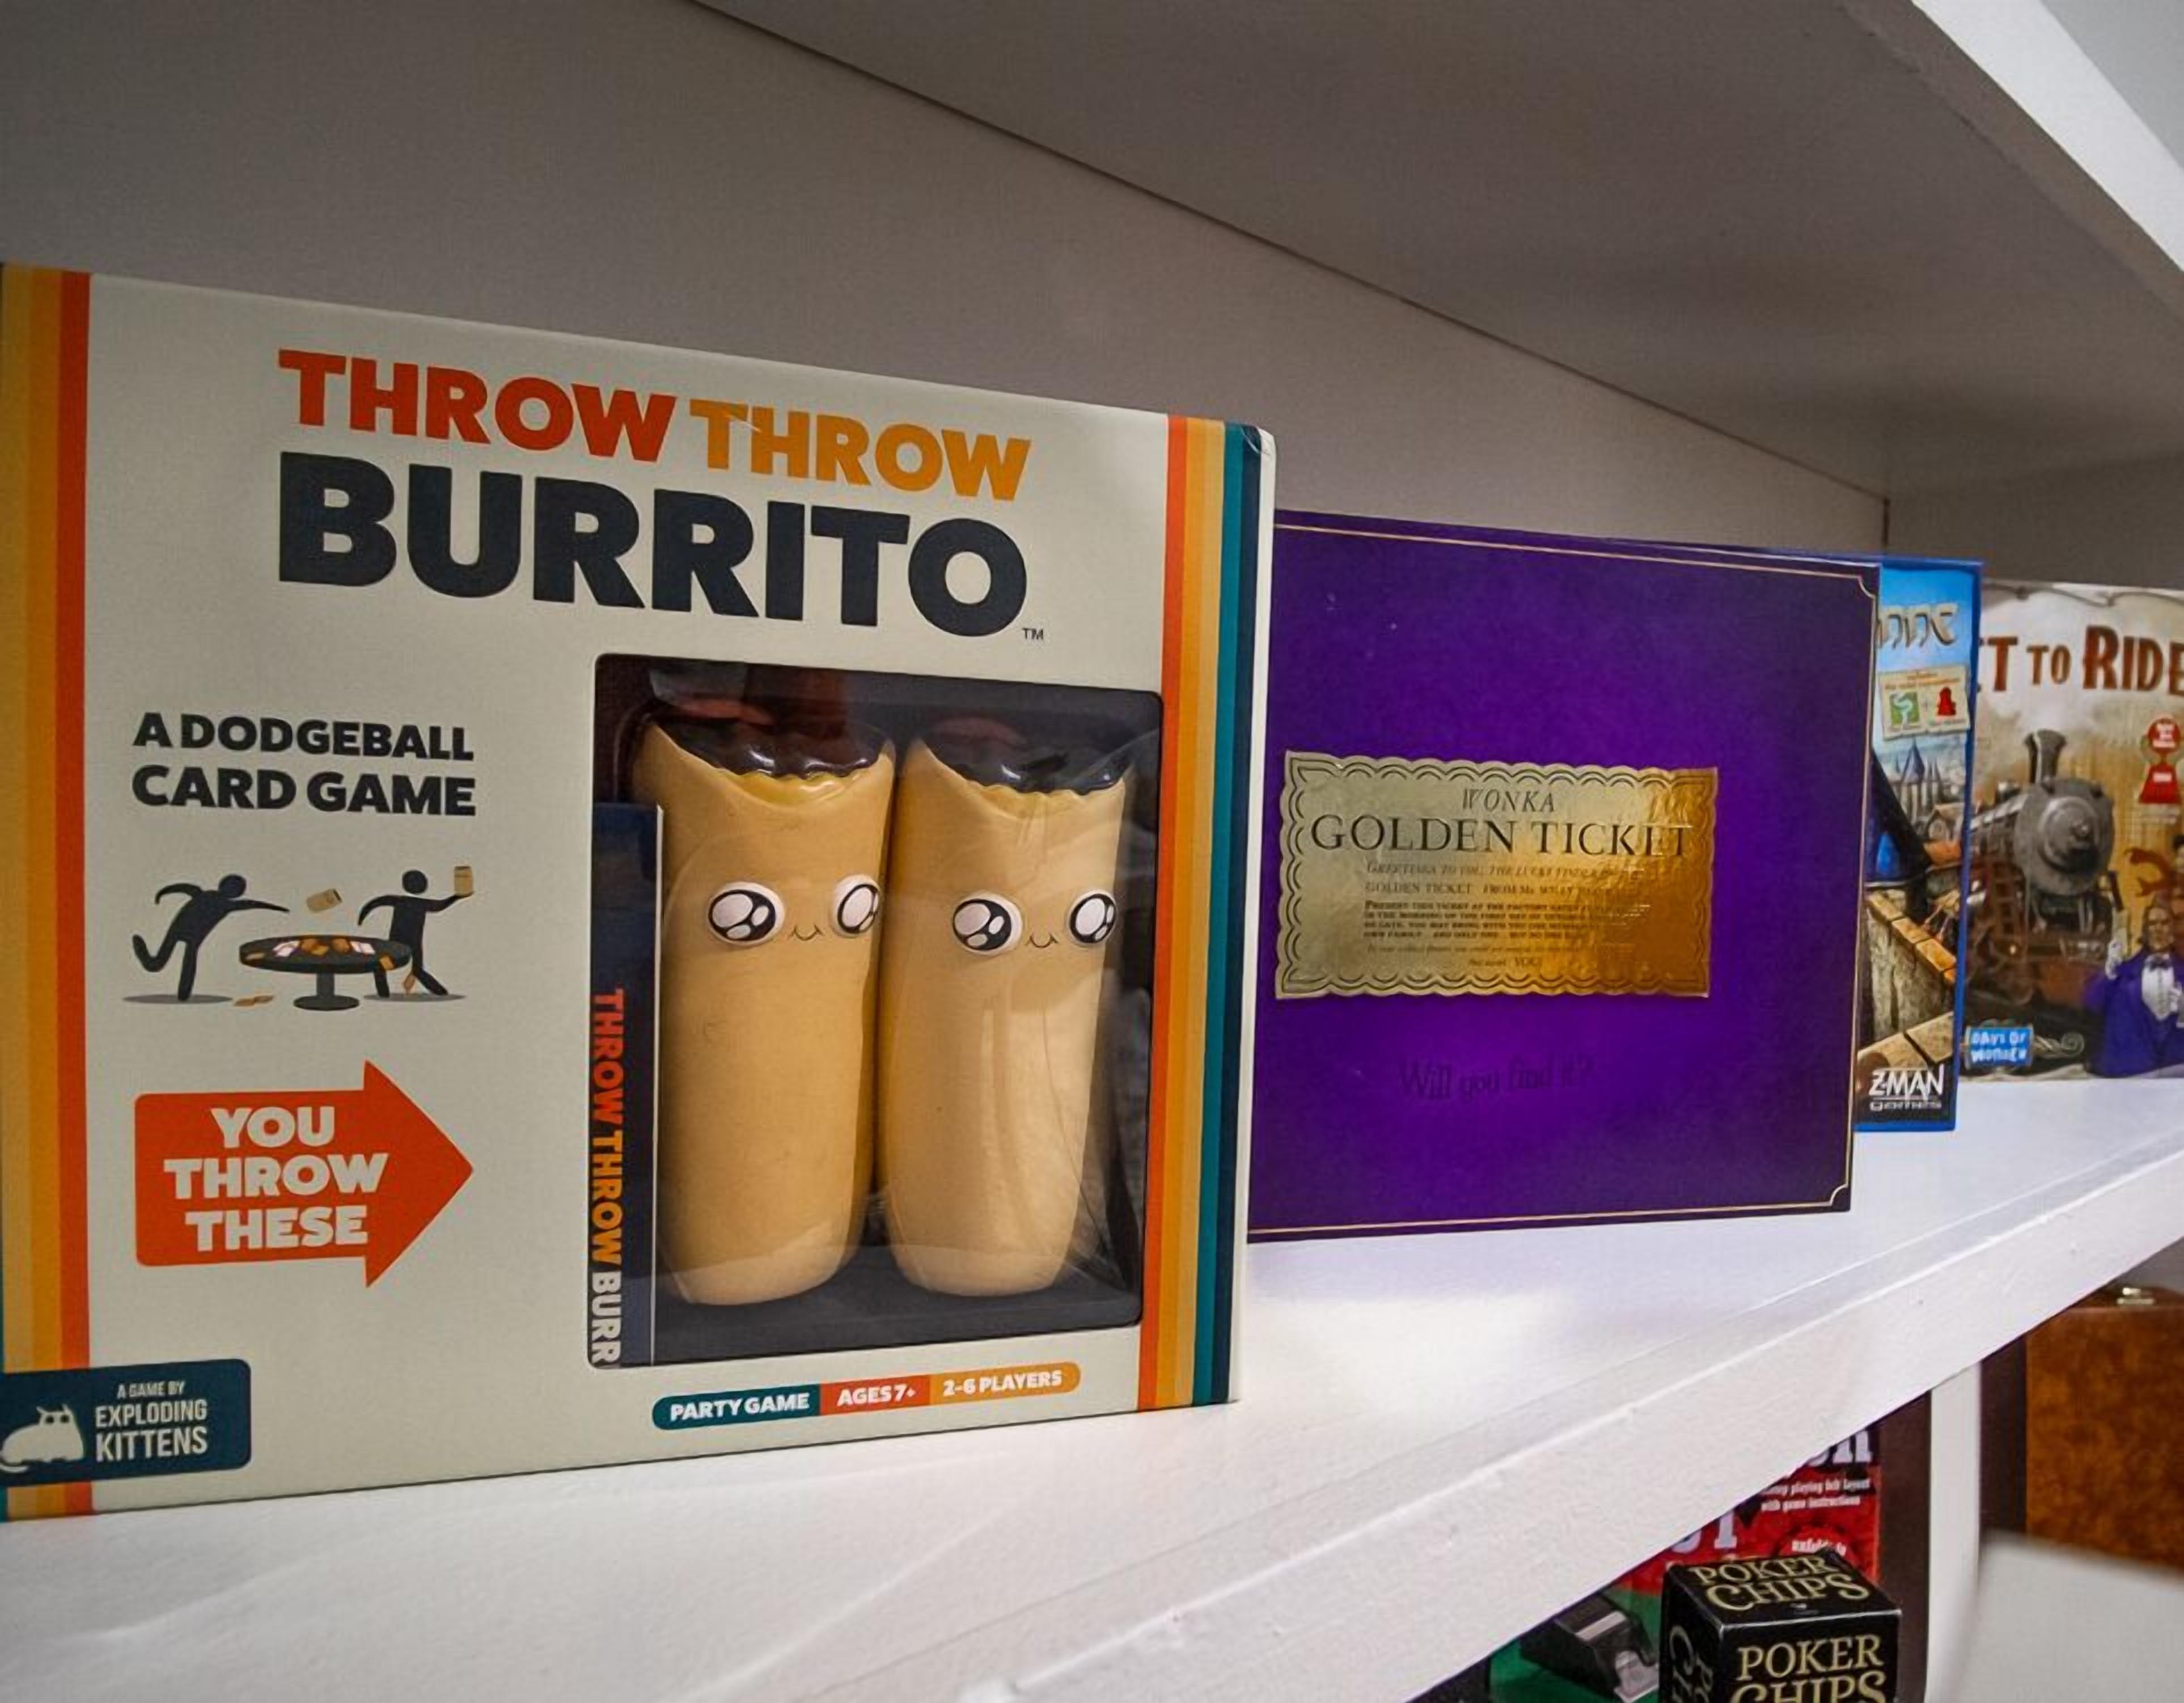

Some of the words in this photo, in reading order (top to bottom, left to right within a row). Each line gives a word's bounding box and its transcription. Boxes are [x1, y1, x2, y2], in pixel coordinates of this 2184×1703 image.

[278, 349, 676, 463] THROW
[690, 399, 1031, 501] THROW
[279, 451, 1027, 637] BURRITO
[1979, 636, 2018, 692] T
[2026, 645, 2072, 685] TO
[2083, 625, 2184, 698] RIDE
[133, 712, 173, 748] A
[181, 713, 474, 761] DODGEBALL
[132, 765, 297, 810] CARD
[306, 771, 476, 816] GAME
[1462, 787, 1556, 814] WONKA
[1311, 814, 1517, 854] GOLDEN
[1531, 821, 1694, 857] TICKET
[592, 988, 624, 1125] THROW
[210, 1106, 335, 1149] YOU
[163, 1153, 390, 1200] THROW
[592, 1129, 623, 1266] THROW
[185, 1205, 368, 1252] THESE
[117, 1384, 125, 1399] A
[129, 1382, 164, 1398] GAME
[168, 1380, 186, 1396] BY
[837, 1385, 892, 1406] AGES
[943, 1379, 976, 1397] 2-6
[979, 1370, 1063, 1392] PLAYERS
[95, 1399, 208, 1428] EXPLODING
[670, 1398, 743, 1422] PARTY
[744, 1392, 810, 1415] GAME
[95, 1426, 209, 1463] KITTENS
[1687, 1556, 1839, 1586] POKER
[1705, 1573, 1870, 1611] CHIPS
[1736, 1634, 1884, 1681] POKER
